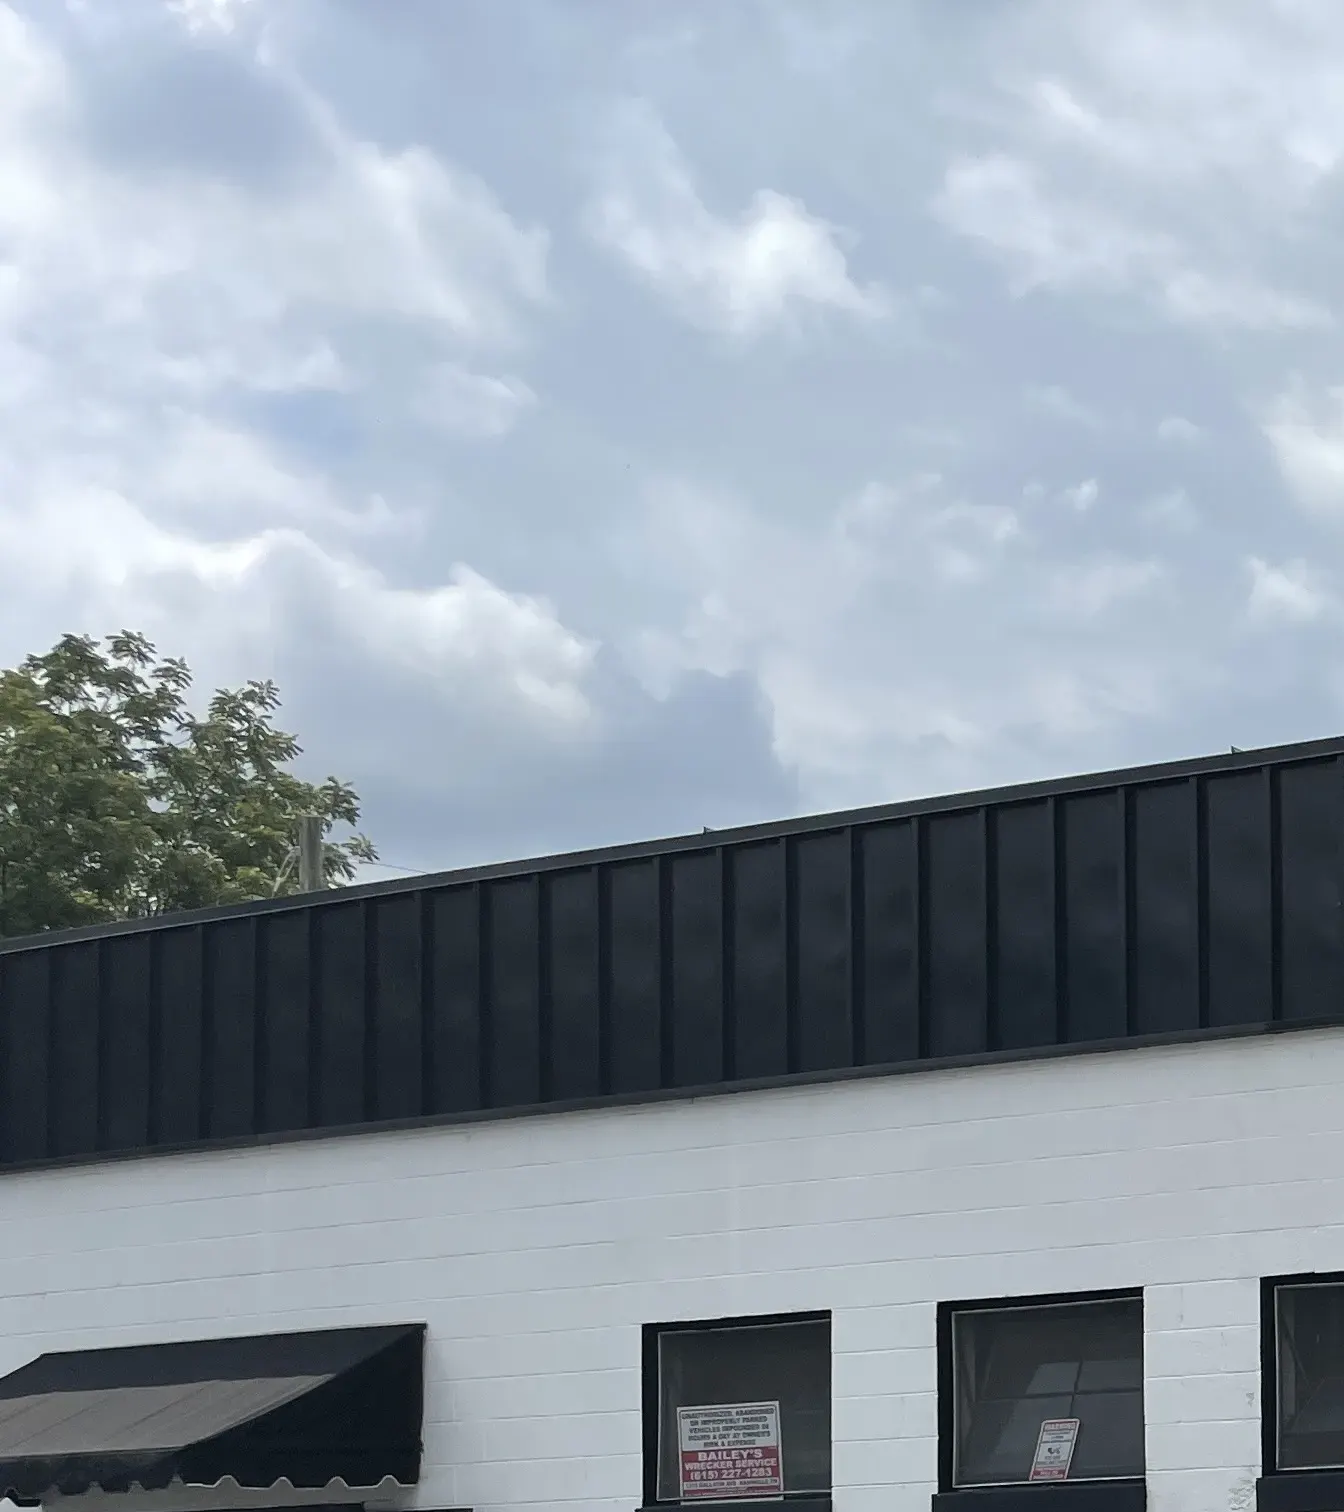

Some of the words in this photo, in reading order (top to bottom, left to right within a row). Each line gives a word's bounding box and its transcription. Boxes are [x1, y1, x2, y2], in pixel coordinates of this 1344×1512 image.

[698, 1449, 763, 1461] BAILEY'S
[684, 1460, 733, 1471] WRECKER
[735, 1458, 777, 1467] SERVICE
[690, 1471, 718, 1480] (615)
